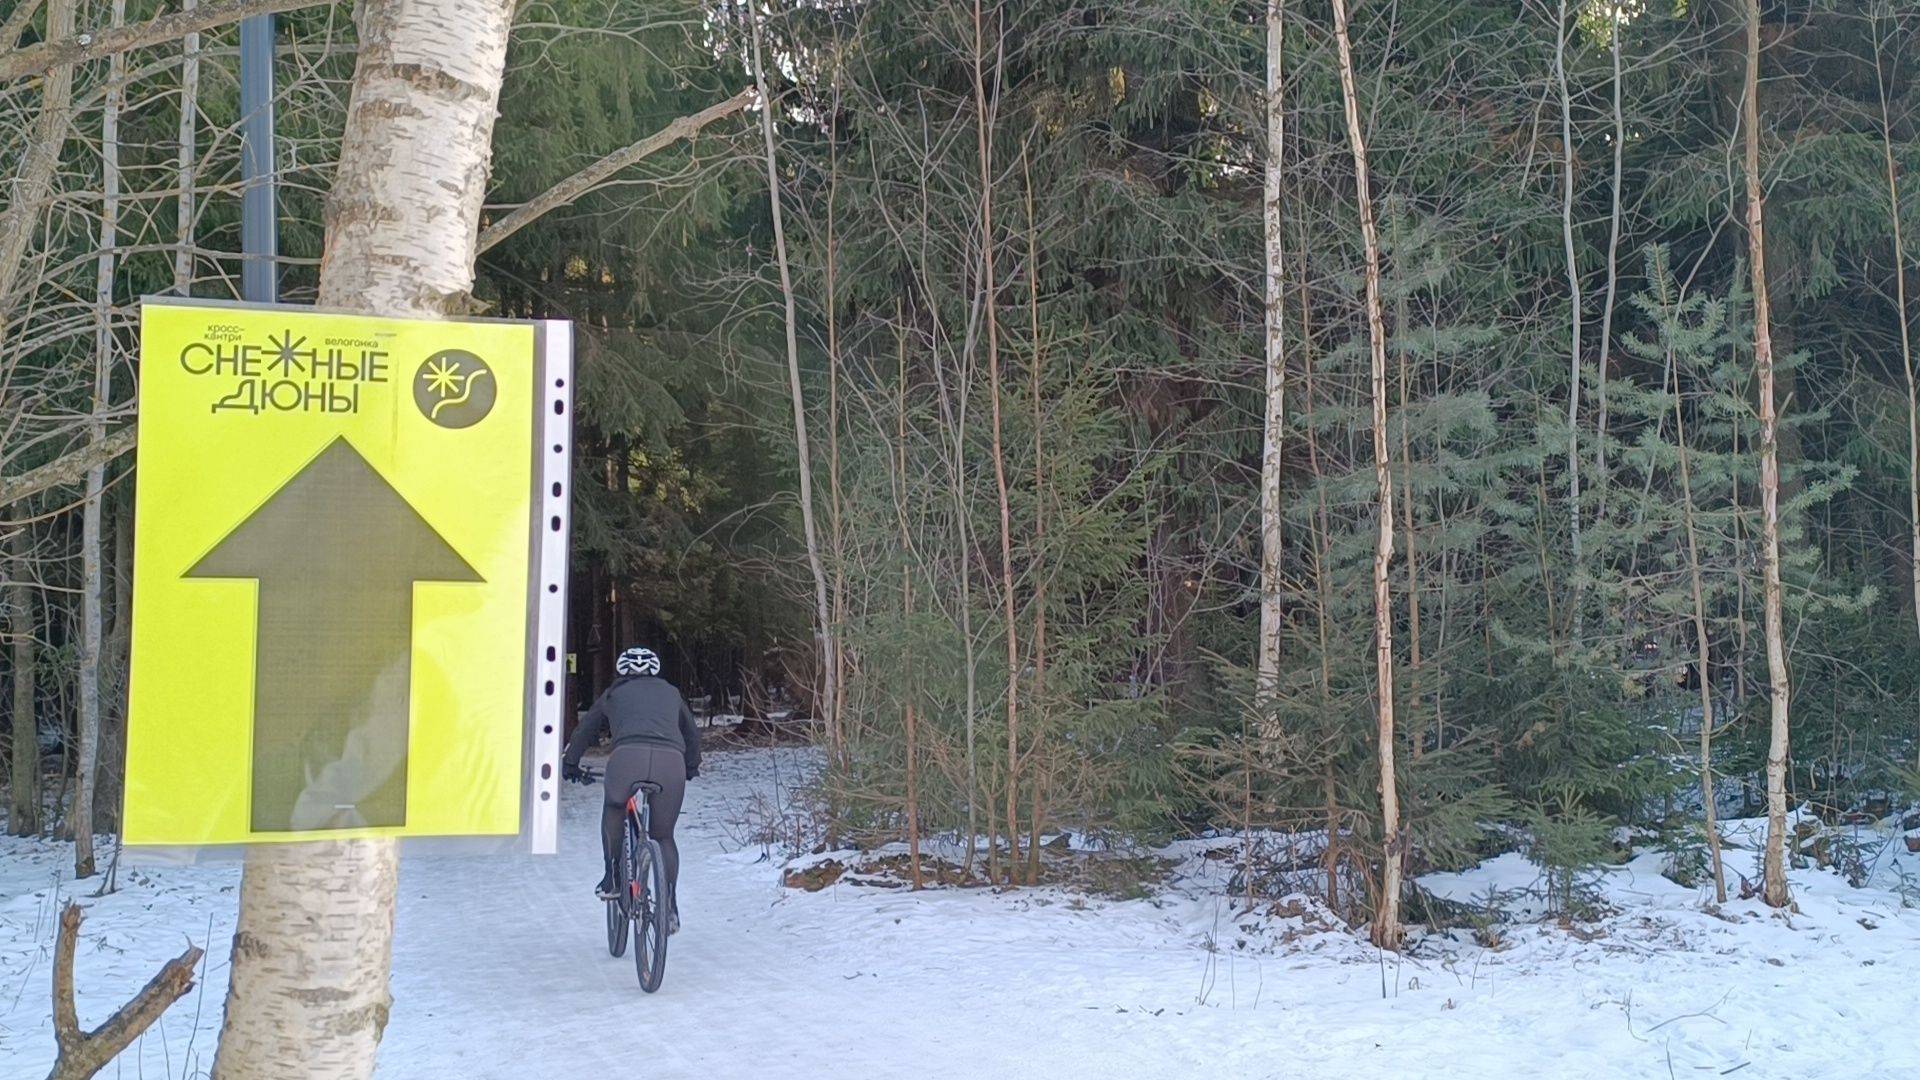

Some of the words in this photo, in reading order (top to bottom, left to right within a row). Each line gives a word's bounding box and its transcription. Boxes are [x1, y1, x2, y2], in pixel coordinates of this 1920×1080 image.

[207, 324, 246, 334] кросс-
[204, 332, 242, 343] кантри
[325, 337, 379, 348] велогонка
[211, 380, 359, 415] ДЮНЫ
